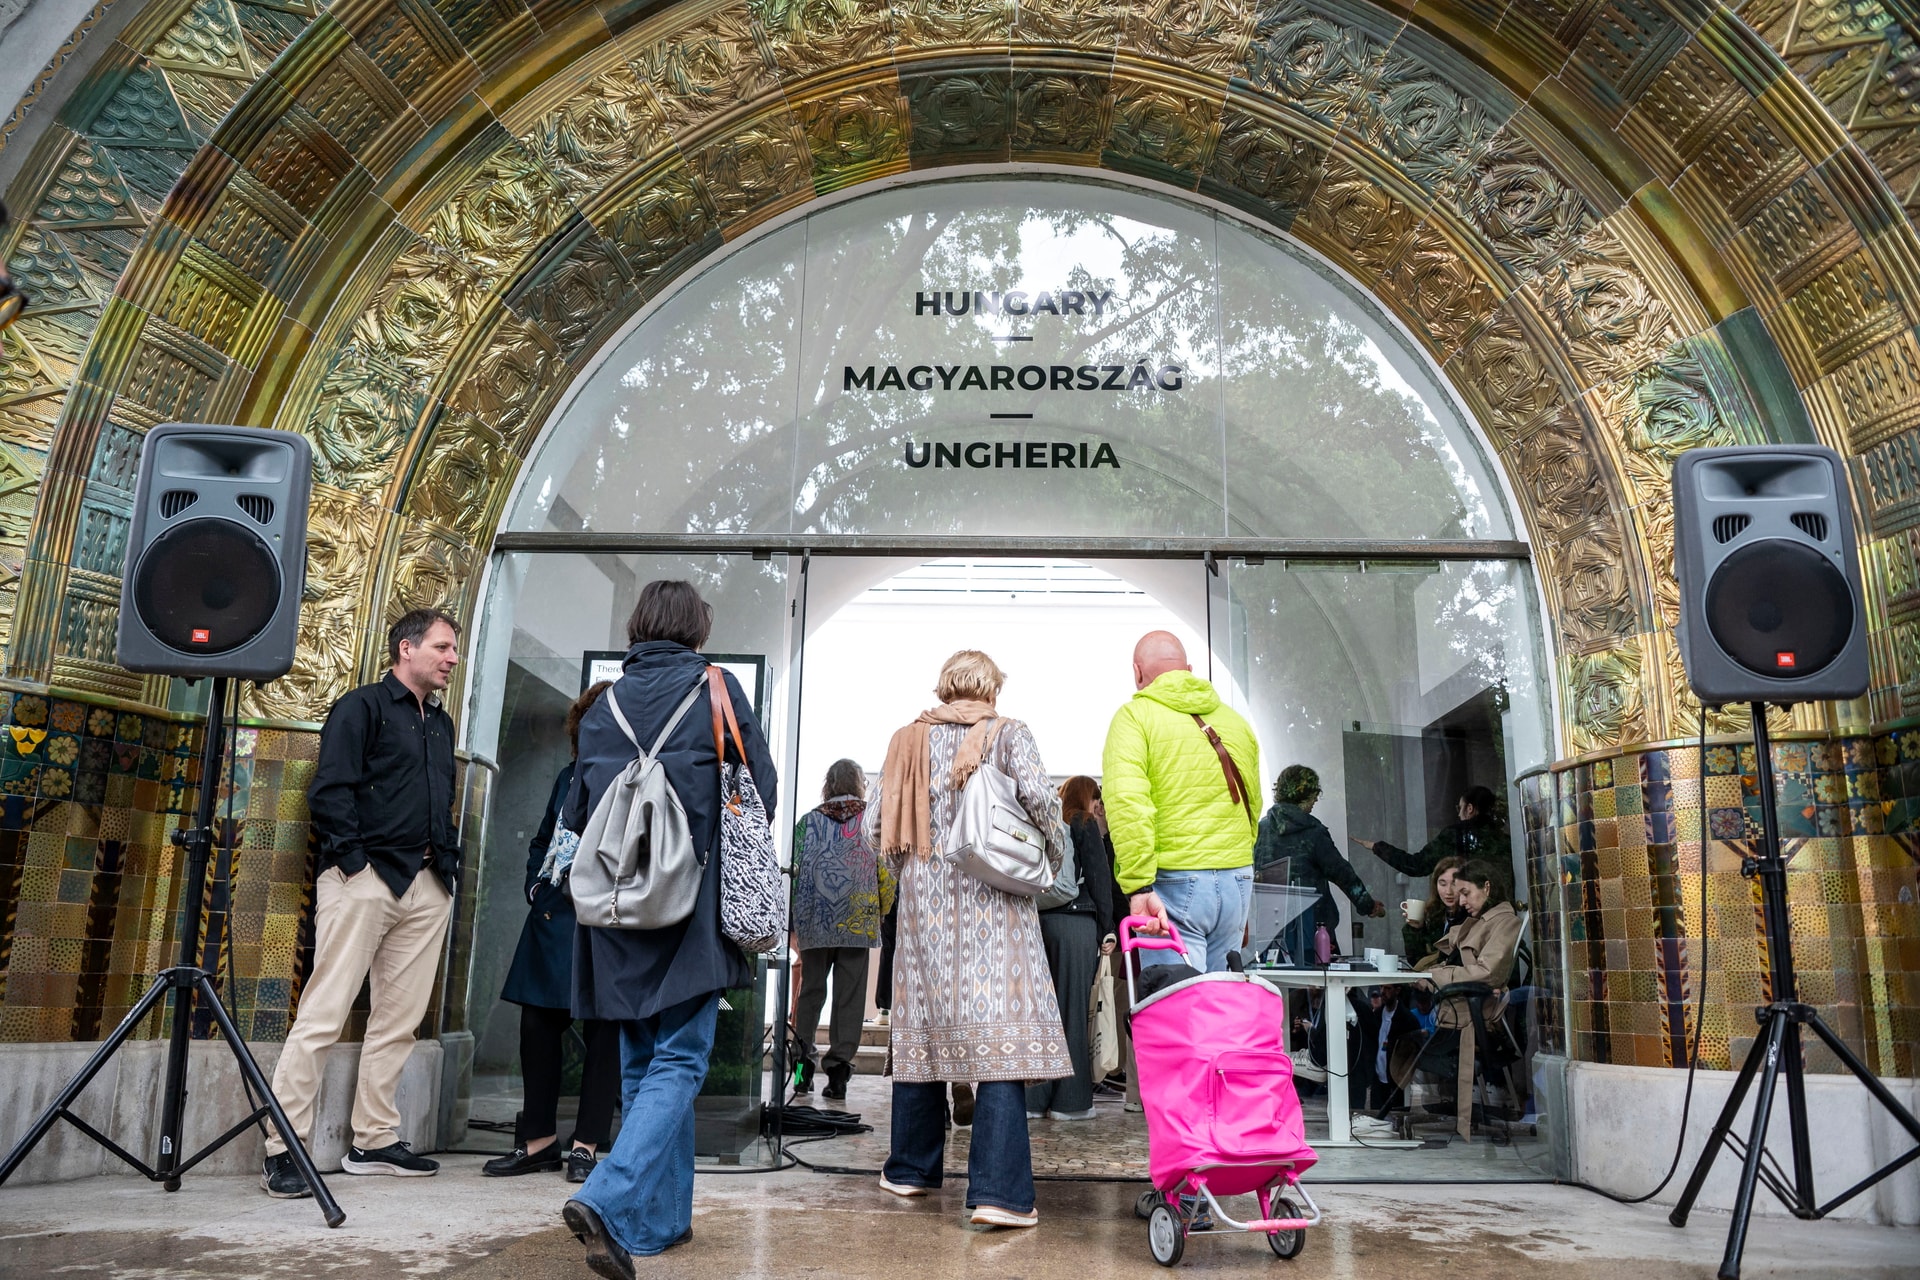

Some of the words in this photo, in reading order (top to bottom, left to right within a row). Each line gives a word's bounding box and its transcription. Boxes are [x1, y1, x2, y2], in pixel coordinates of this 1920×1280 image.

[915, 291, 1113, 316] HUNGARY
[843, 358, 1183, 391] MAGYARORSZÁG
[905, 442, 1121, 469] UNGHERIA
